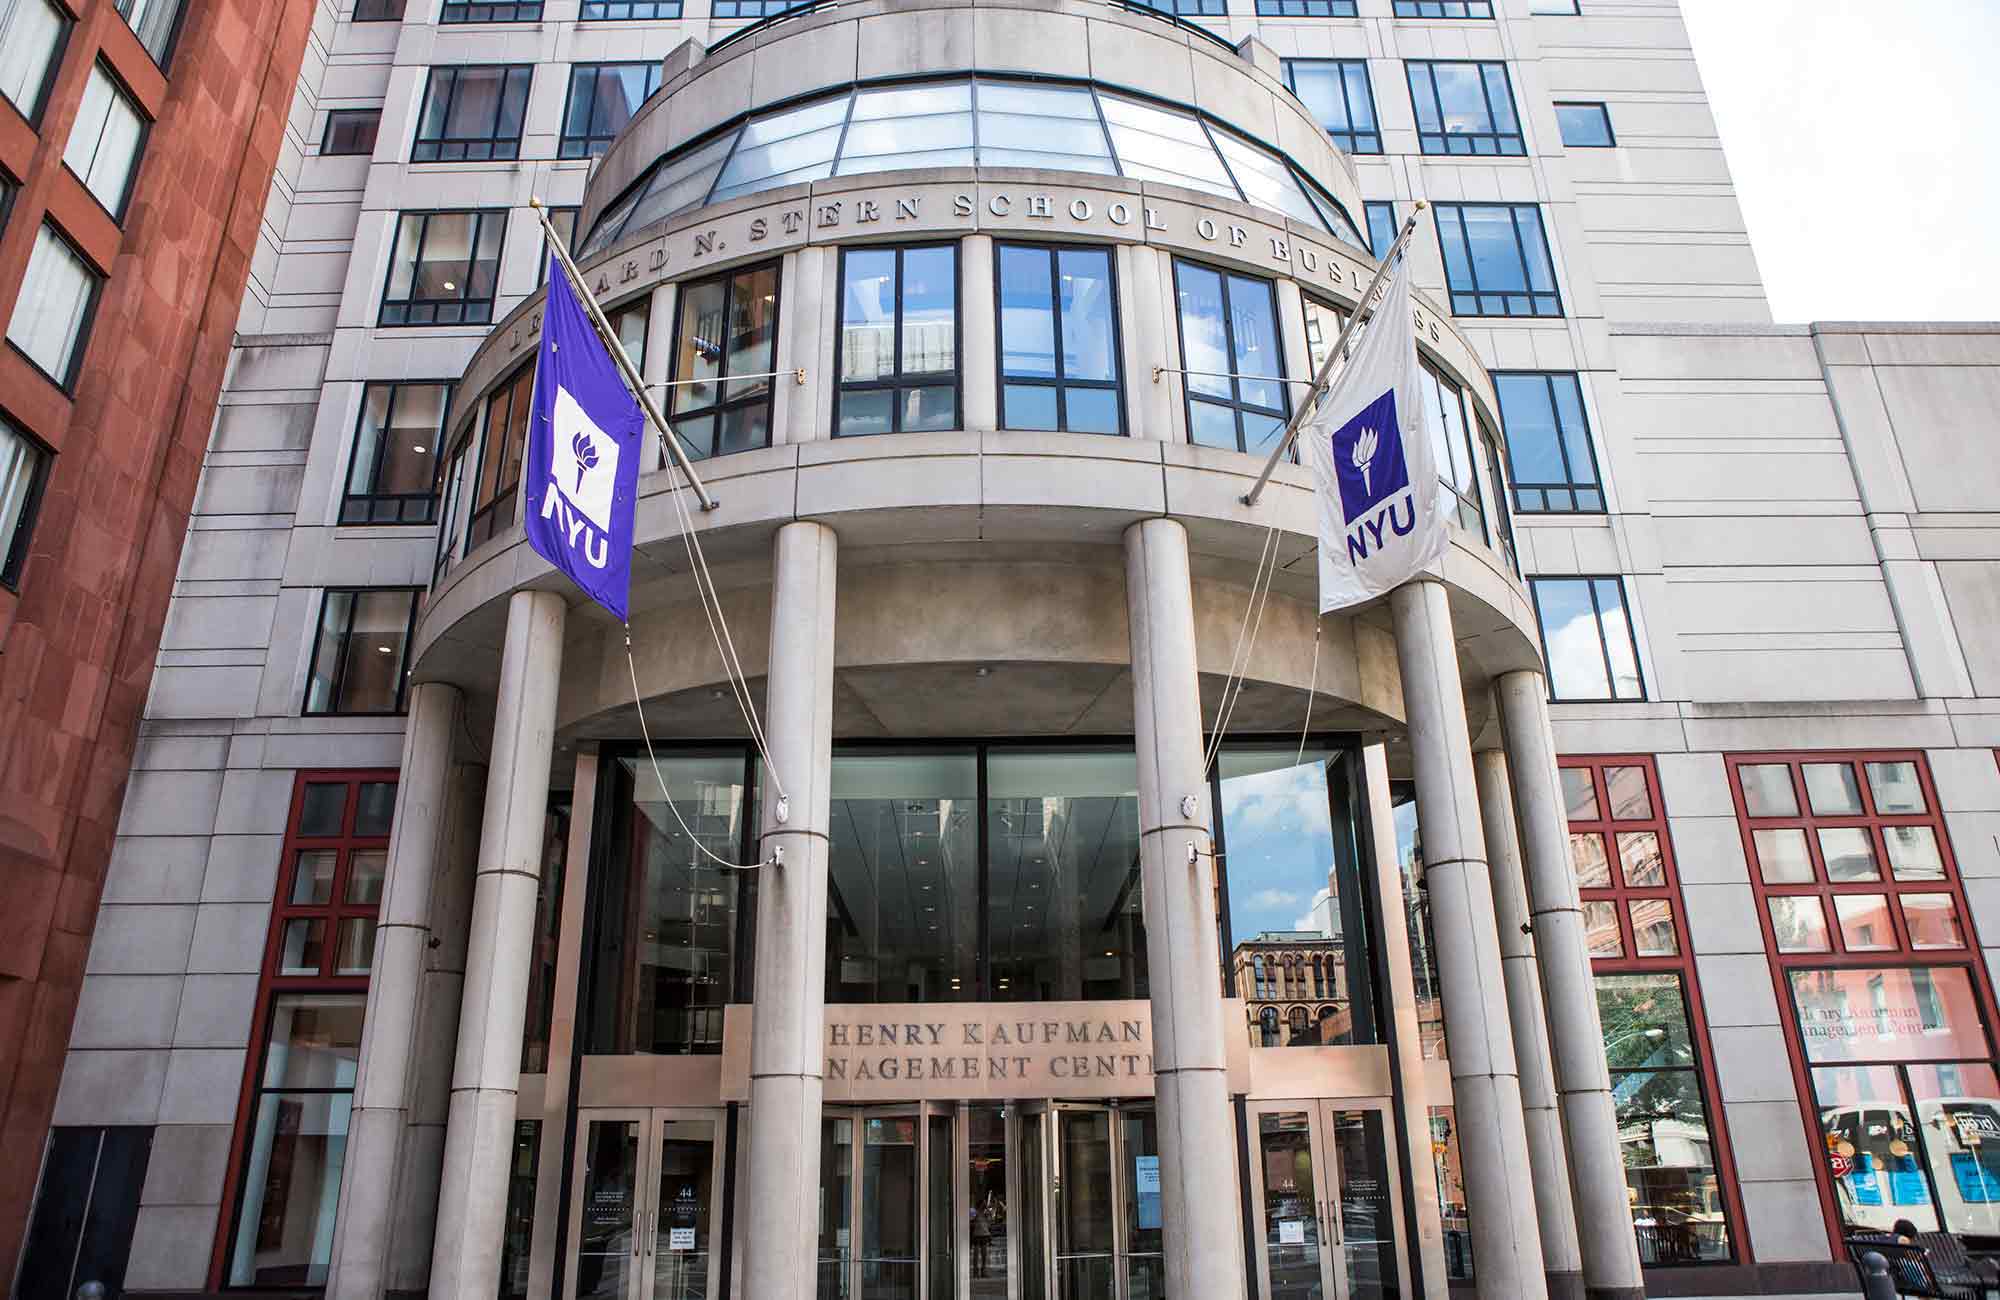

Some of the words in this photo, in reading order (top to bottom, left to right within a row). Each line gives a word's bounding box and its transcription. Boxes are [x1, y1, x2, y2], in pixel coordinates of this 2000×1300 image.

[510, 249, 669, 352] LEARD
[693, 231, 728, 257] N.
[750, 197, 921, 241] STERN
[953, 194, 1168, 232] SCHOOL
[1197, 217, 1248, 248] OF
[1270, 238, 1440, 344] BUSISS
[541, 481, 609, 569] NYU
[1346, 493, 1416, 567] NYU
[829, 1022, 946, 1047] HENRY
[962, 1020, 1143, 1045] KAUFMAN
[828, 1055, 1033, 1081] NAGEMENT
[1049, 1054, 1154, 1078] CENT
[680, 1187, 693, 1198] 44
